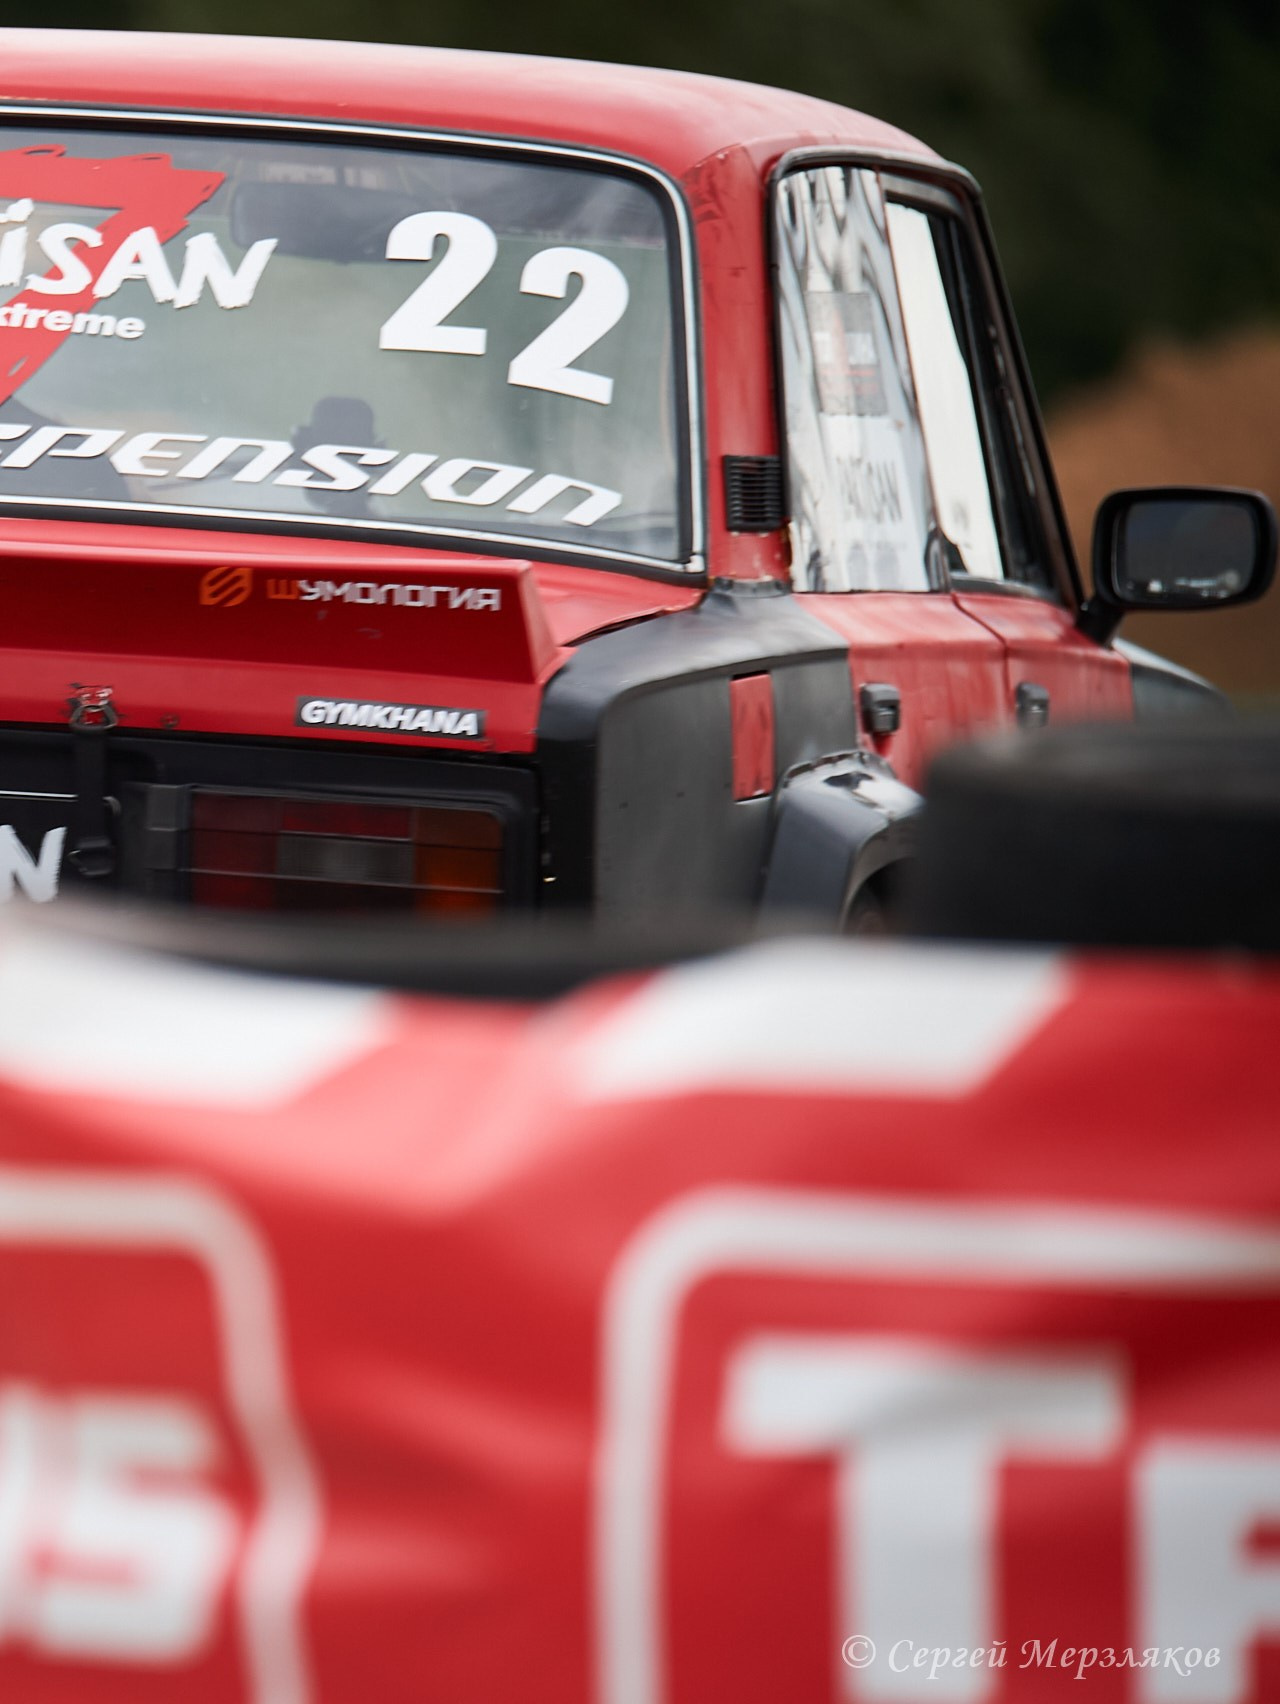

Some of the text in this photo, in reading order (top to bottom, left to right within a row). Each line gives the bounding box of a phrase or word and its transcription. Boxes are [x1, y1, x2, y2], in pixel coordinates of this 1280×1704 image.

[380, 211, 629, 405] 22
[268, 579, 501, 611] ШУМОЛОГИЯ
[300, 700, 479, 736] GYMKHANA
